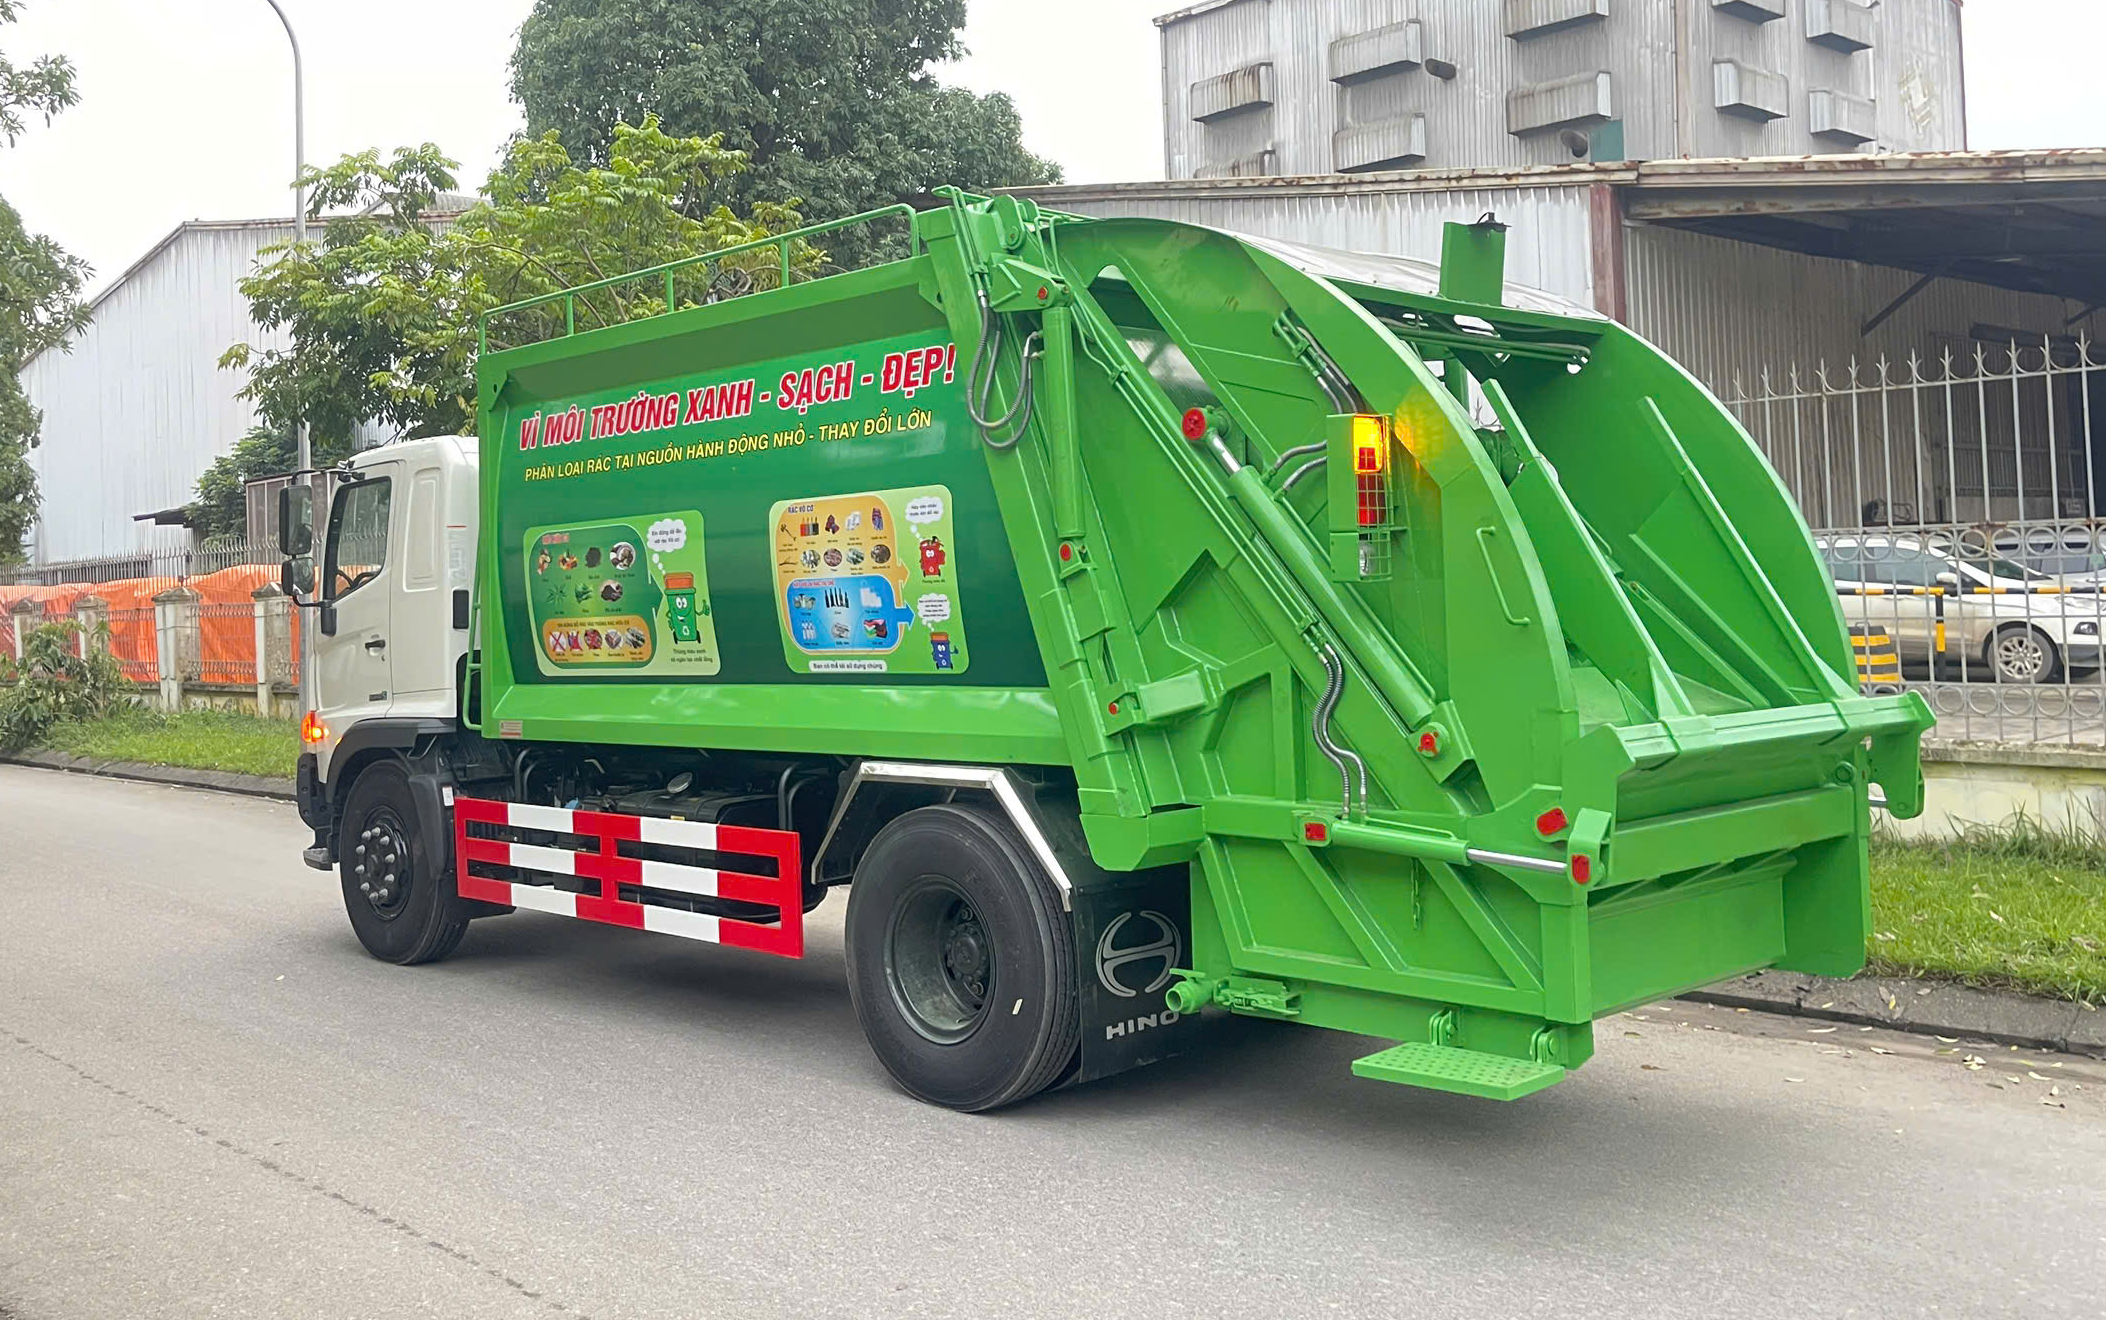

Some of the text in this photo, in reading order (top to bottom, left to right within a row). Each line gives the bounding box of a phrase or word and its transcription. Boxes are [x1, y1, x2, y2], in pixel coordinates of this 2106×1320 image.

[520, 343, 956, 450] VÌ MÔI TRƯỜNG XANH - SẠCH - ĐẸP!
[525, 462, 555, 481] PHÂN
[558, 460, 584, 479] LOẠI
[615, 455, 634, 472] TẠI
[637, 442, 682, 467] NGUỒN
[686, 438, 724, 460] HÀNH
[728, 434, 768, 455] ĐỘNG
[773, 422, 806, 448] NHỎ
[819, 421, 860, 441] THAY
[864, 407, 892, 435] ĐỔI
[897, 408, 931, 431] LỚN
[1106, 1010, 1180, 1040] HINO
